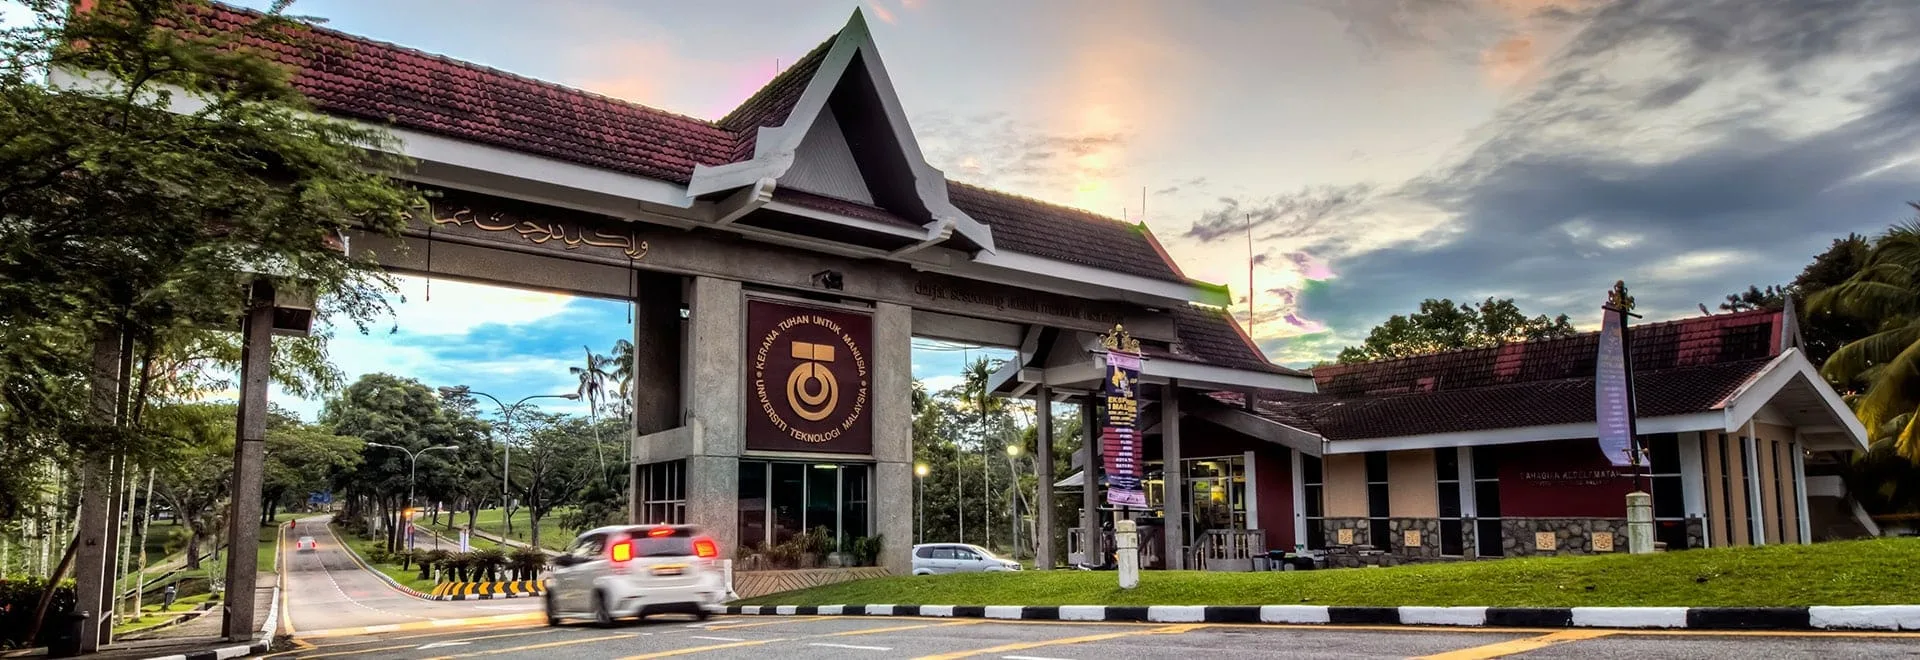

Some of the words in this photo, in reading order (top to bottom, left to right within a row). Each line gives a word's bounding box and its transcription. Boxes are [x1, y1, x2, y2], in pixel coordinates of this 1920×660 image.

[756, 330, 779, 370] KERANA
[778, 315, 809, 331] TUHAN
[813, 315, 842, 335] UNTUK
[842, 333, 867, 376] MANUSIA
[756, 380, 788, 432] UNIVERSITI
[789, 428, 841, 442] TEKNOLOGI
[842, 387, 867, 431] MALAYSIA
